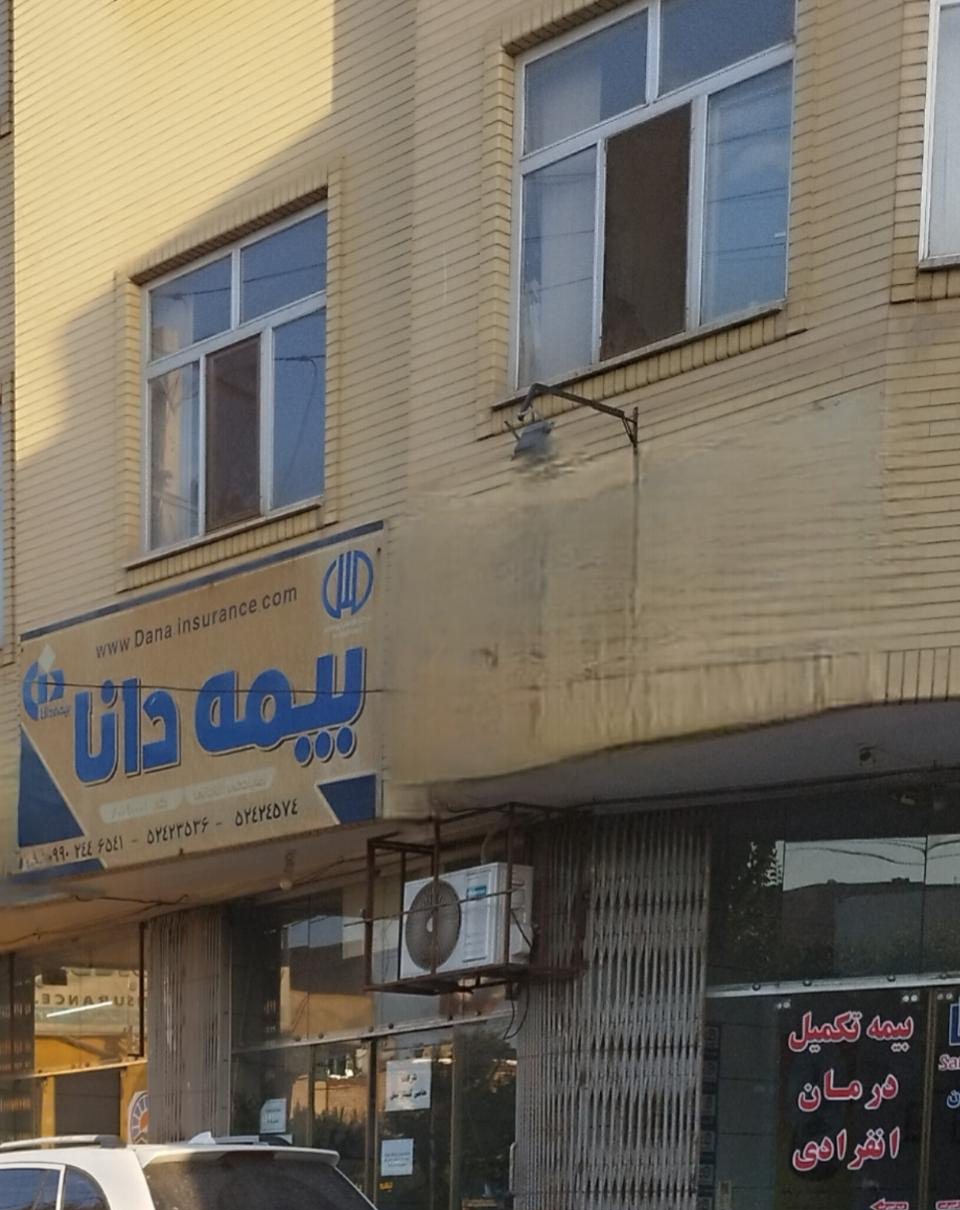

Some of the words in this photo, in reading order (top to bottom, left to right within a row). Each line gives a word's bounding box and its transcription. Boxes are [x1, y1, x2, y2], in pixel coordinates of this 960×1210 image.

[195, 646, 366, 766] بیمه
[74, 678, 181, 787] دانا
[788, 1010, 863, 1053] تکمیل
[866, 1014, 915, 1053] بیمه
[791, 1126, 901, 1171] انفرادی
